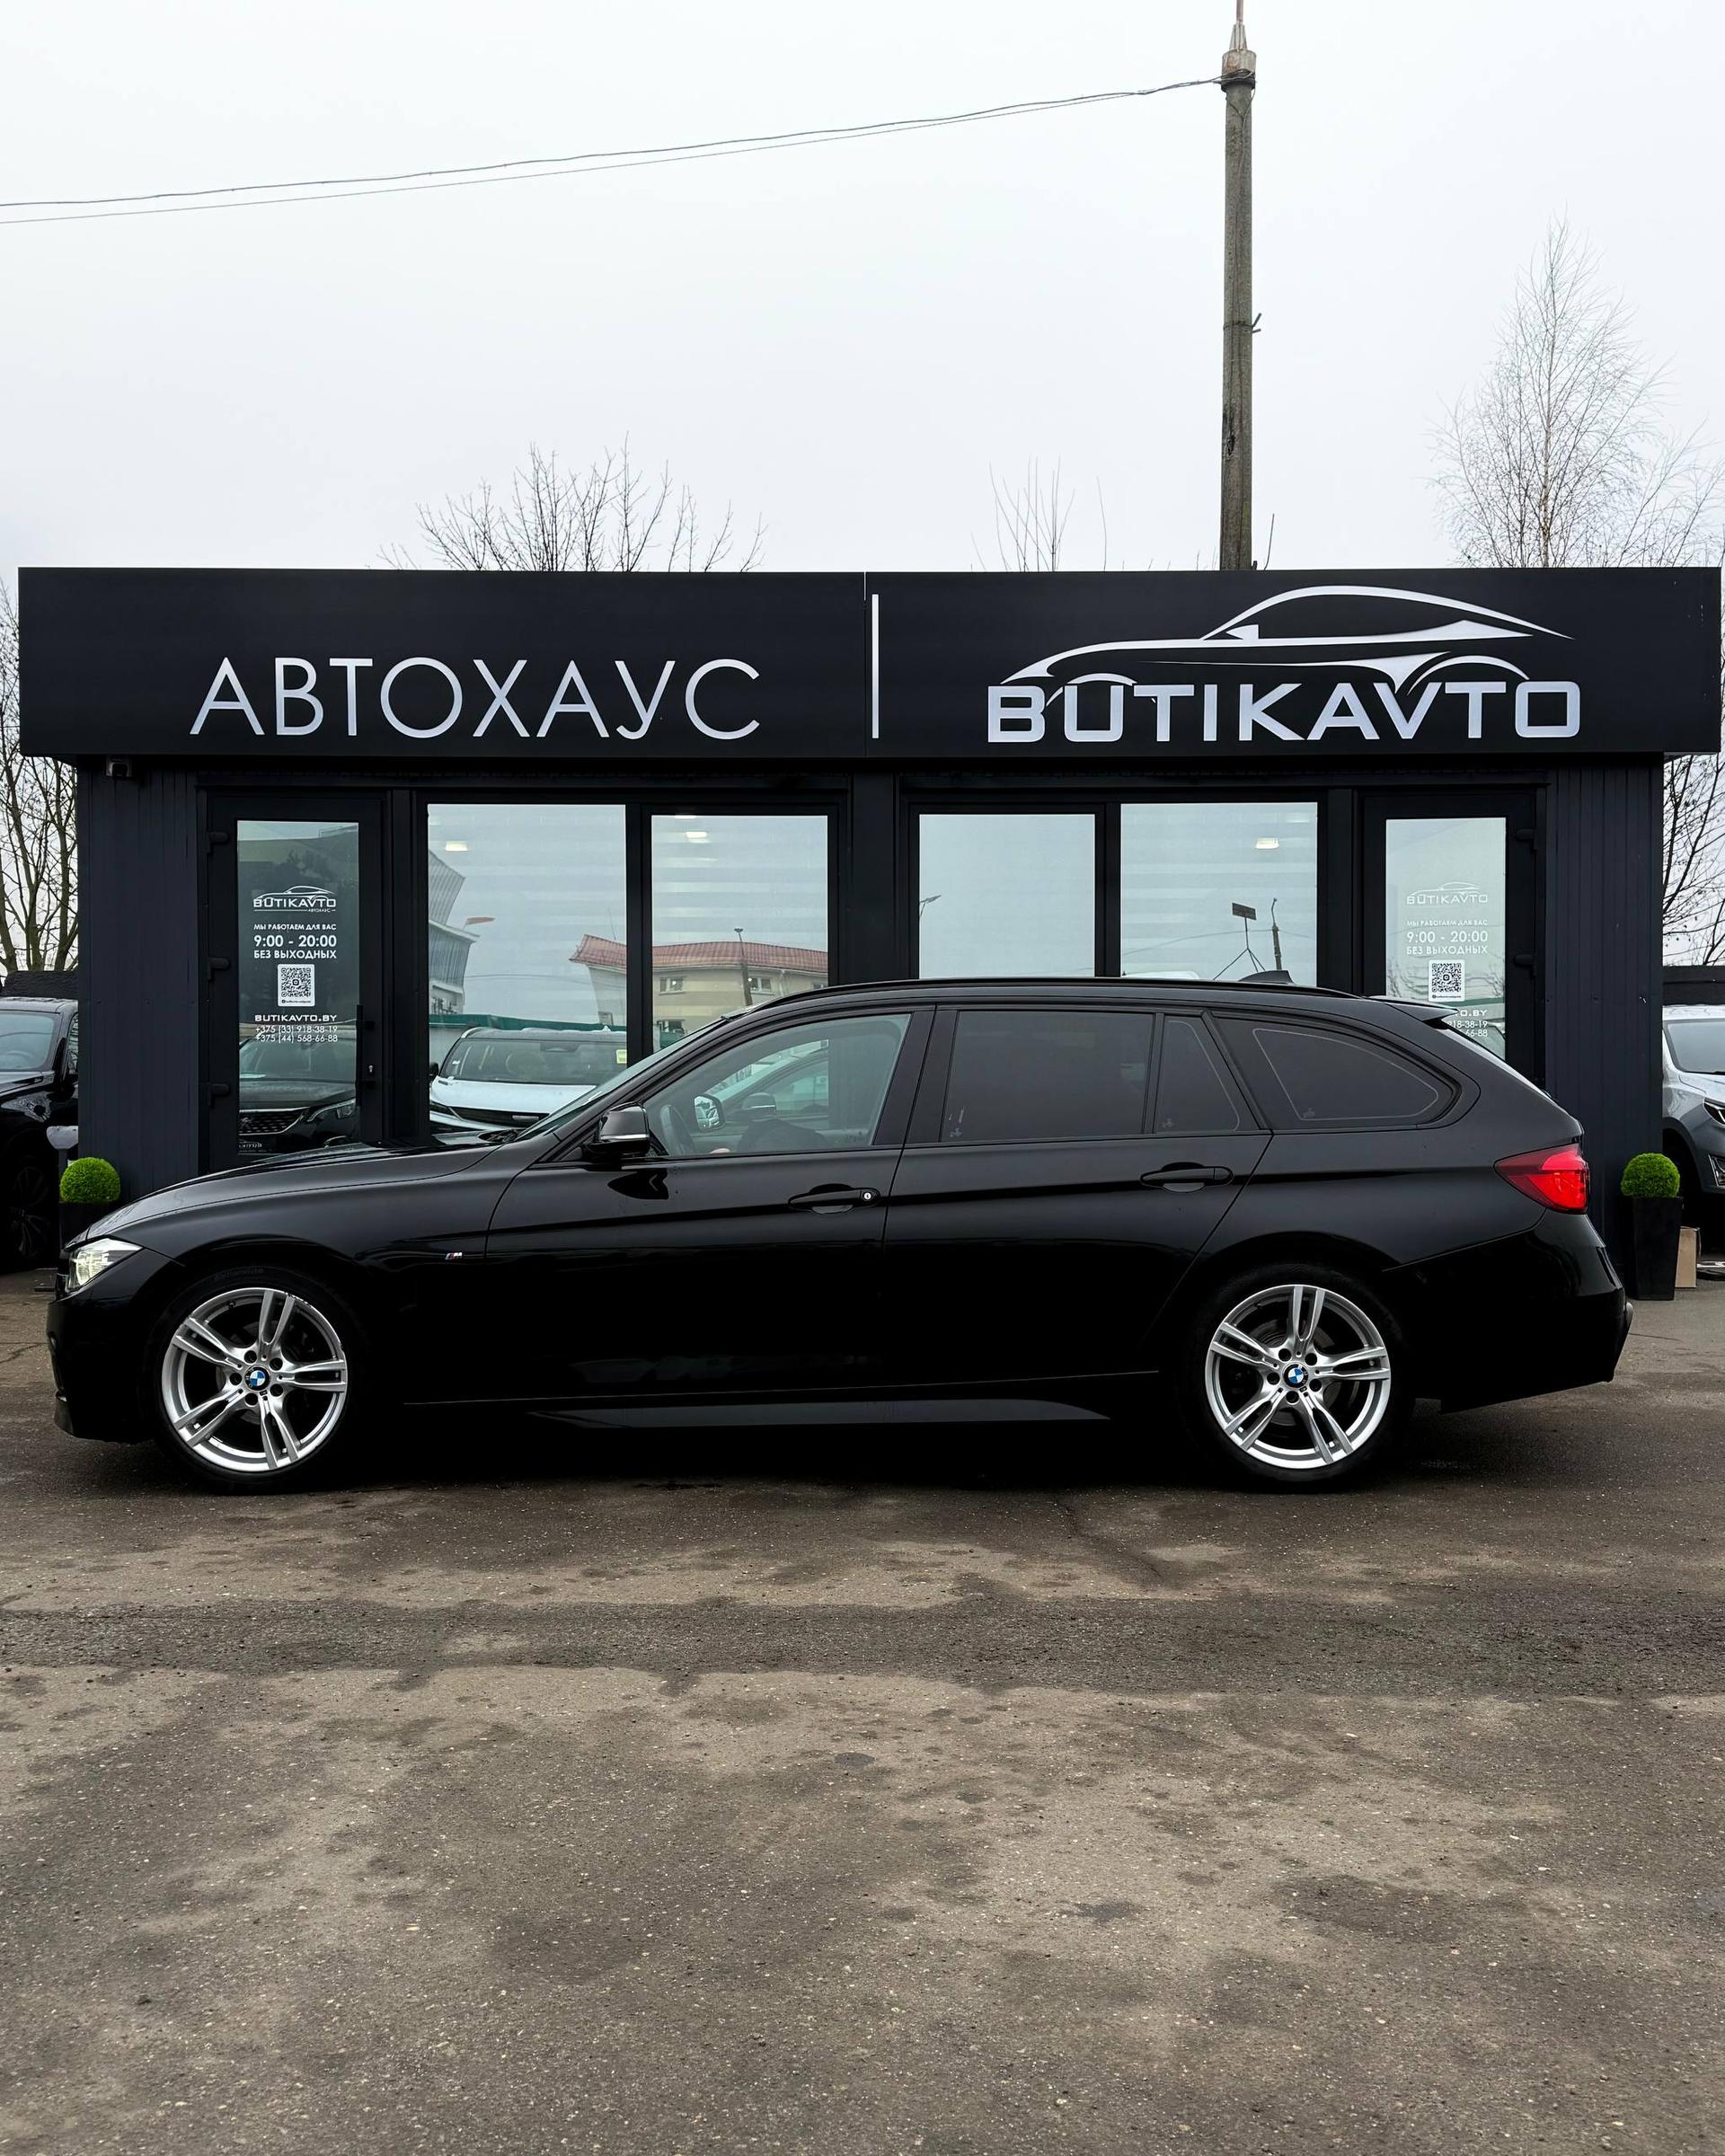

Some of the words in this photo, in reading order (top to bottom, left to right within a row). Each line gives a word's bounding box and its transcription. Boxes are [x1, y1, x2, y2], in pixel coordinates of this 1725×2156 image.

[190, 657, 760, 739] АВТОХАУС
[987, 681, 1581, 743] BUTIKAVTO
[253, 898, 337, 908] BUTIKAVTO
[1406, 894, 1488, 905] BUTIKAVTO
[253, 934, 284, 947] 9:00
[298, 934, 337, 947] 20:00
[1407, 931, 1436, 943] 9:00
[1450, 931, 1488, 943] 20:00
[253, 950, 271, 959] БЕЗ
[274, 950, 337, 959] ВЫХОДНЫХ
[1407, 946, 1423, 955] БЕЗ
[1427, 945, 1488, 955] ВЫХОДНЫХ
[254, 1014, 337, 1022] BUTIKAVTO.BY
[256, 1025, 276, 1033] +375
[279, 1025, 294, 1035] (33)
[296, 1025, 338, 1033] 918-38-19
[279, 1034, 294, 1044] (44)
